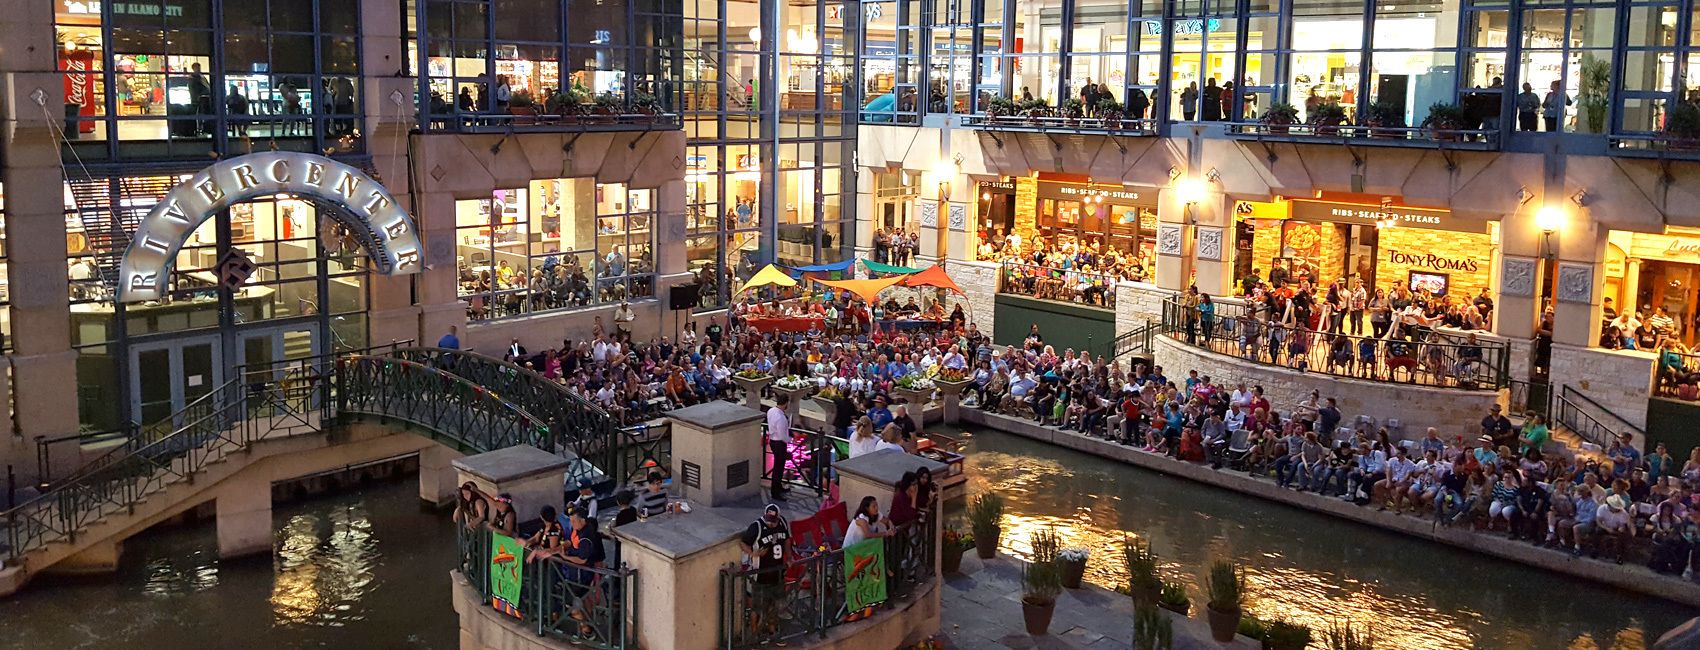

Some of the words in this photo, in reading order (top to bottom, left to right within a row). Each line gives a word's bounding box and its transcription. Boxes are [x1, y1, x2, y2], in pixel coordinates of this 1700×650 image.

[113, 3, 125, 14] IN
[128, 4, 160, 15] ALAMO
[1060, 187, 1077, 195] RIBS
[1112, 191, 1139, 200] STEAKS
[1331, 208, 1353, 217] RIBS
[1404, 214, 1441, 224] STEAKS
[129, 158, 419, 293] RIVERCENTER
[772, 544, 783, 560] 9
